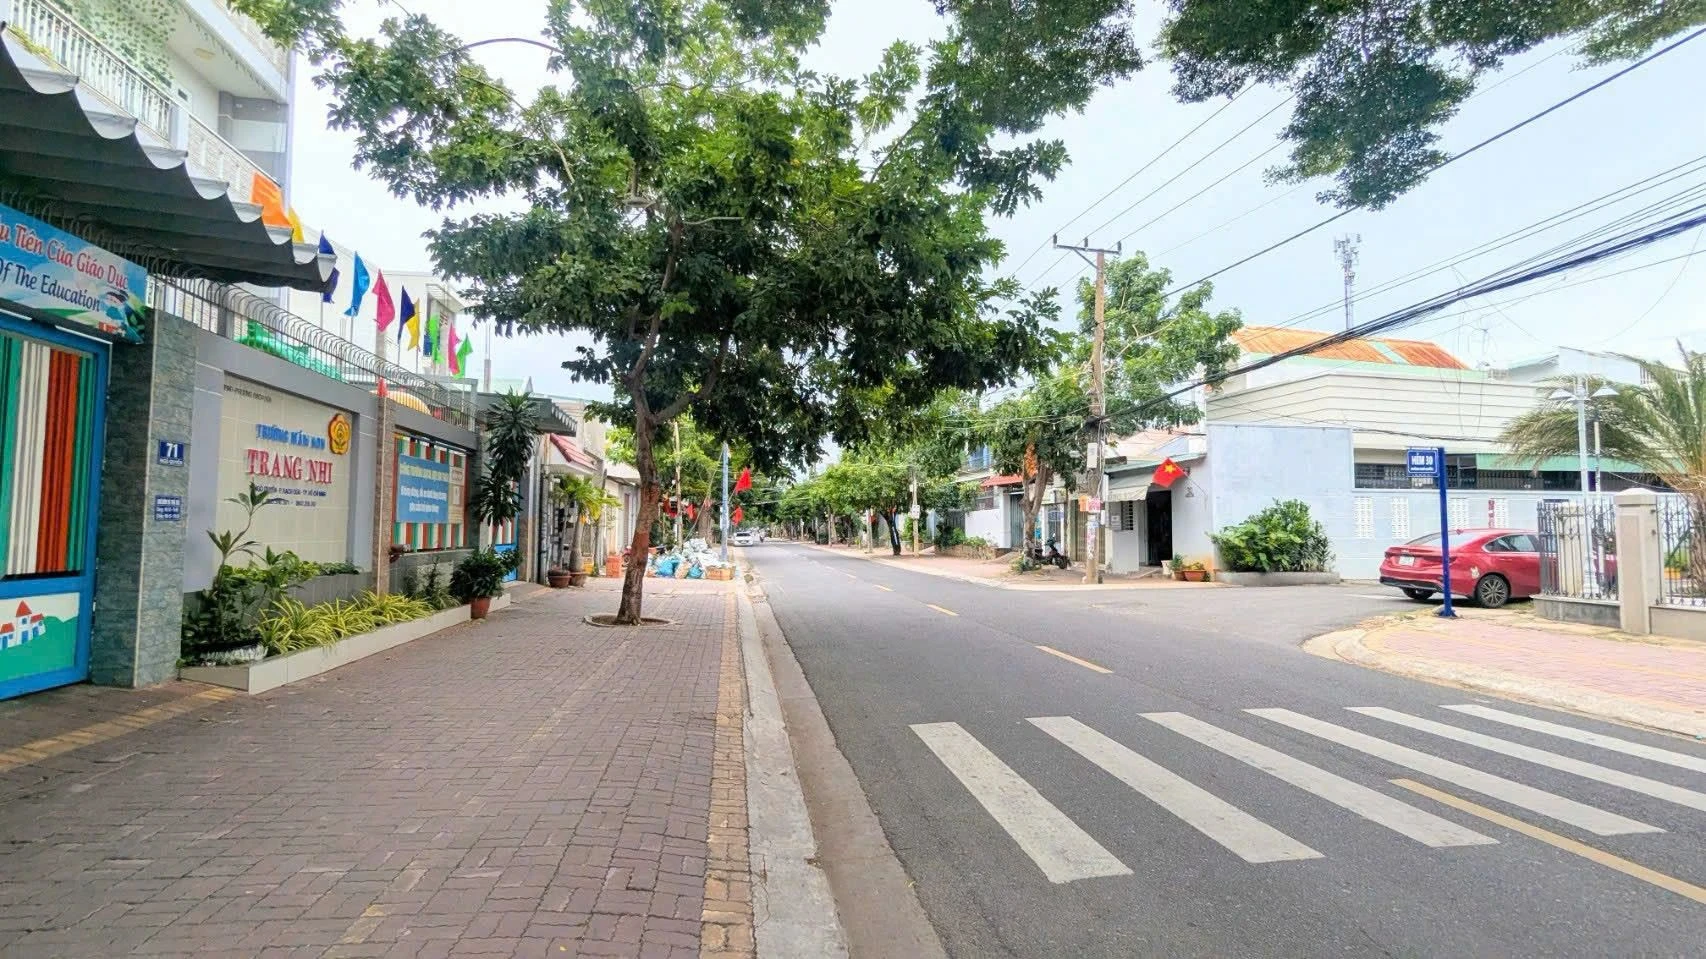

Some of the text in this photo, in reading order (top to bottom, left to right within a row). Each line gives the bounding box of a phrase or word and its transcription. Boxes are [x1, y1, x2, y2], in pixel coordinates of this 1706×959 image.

[15, 223, 43, 255] Tiên
[46, 239, 73, 268] Của
[76, 252, 105, 280] Giáo
[15, 263, 38, 290] The
[40, 274, 100, 312] Education
[166, 442, 178, 458] 71
[247, 449, 333, 484] TRANG NHI
[1425, 455, 1433, 465] 30
